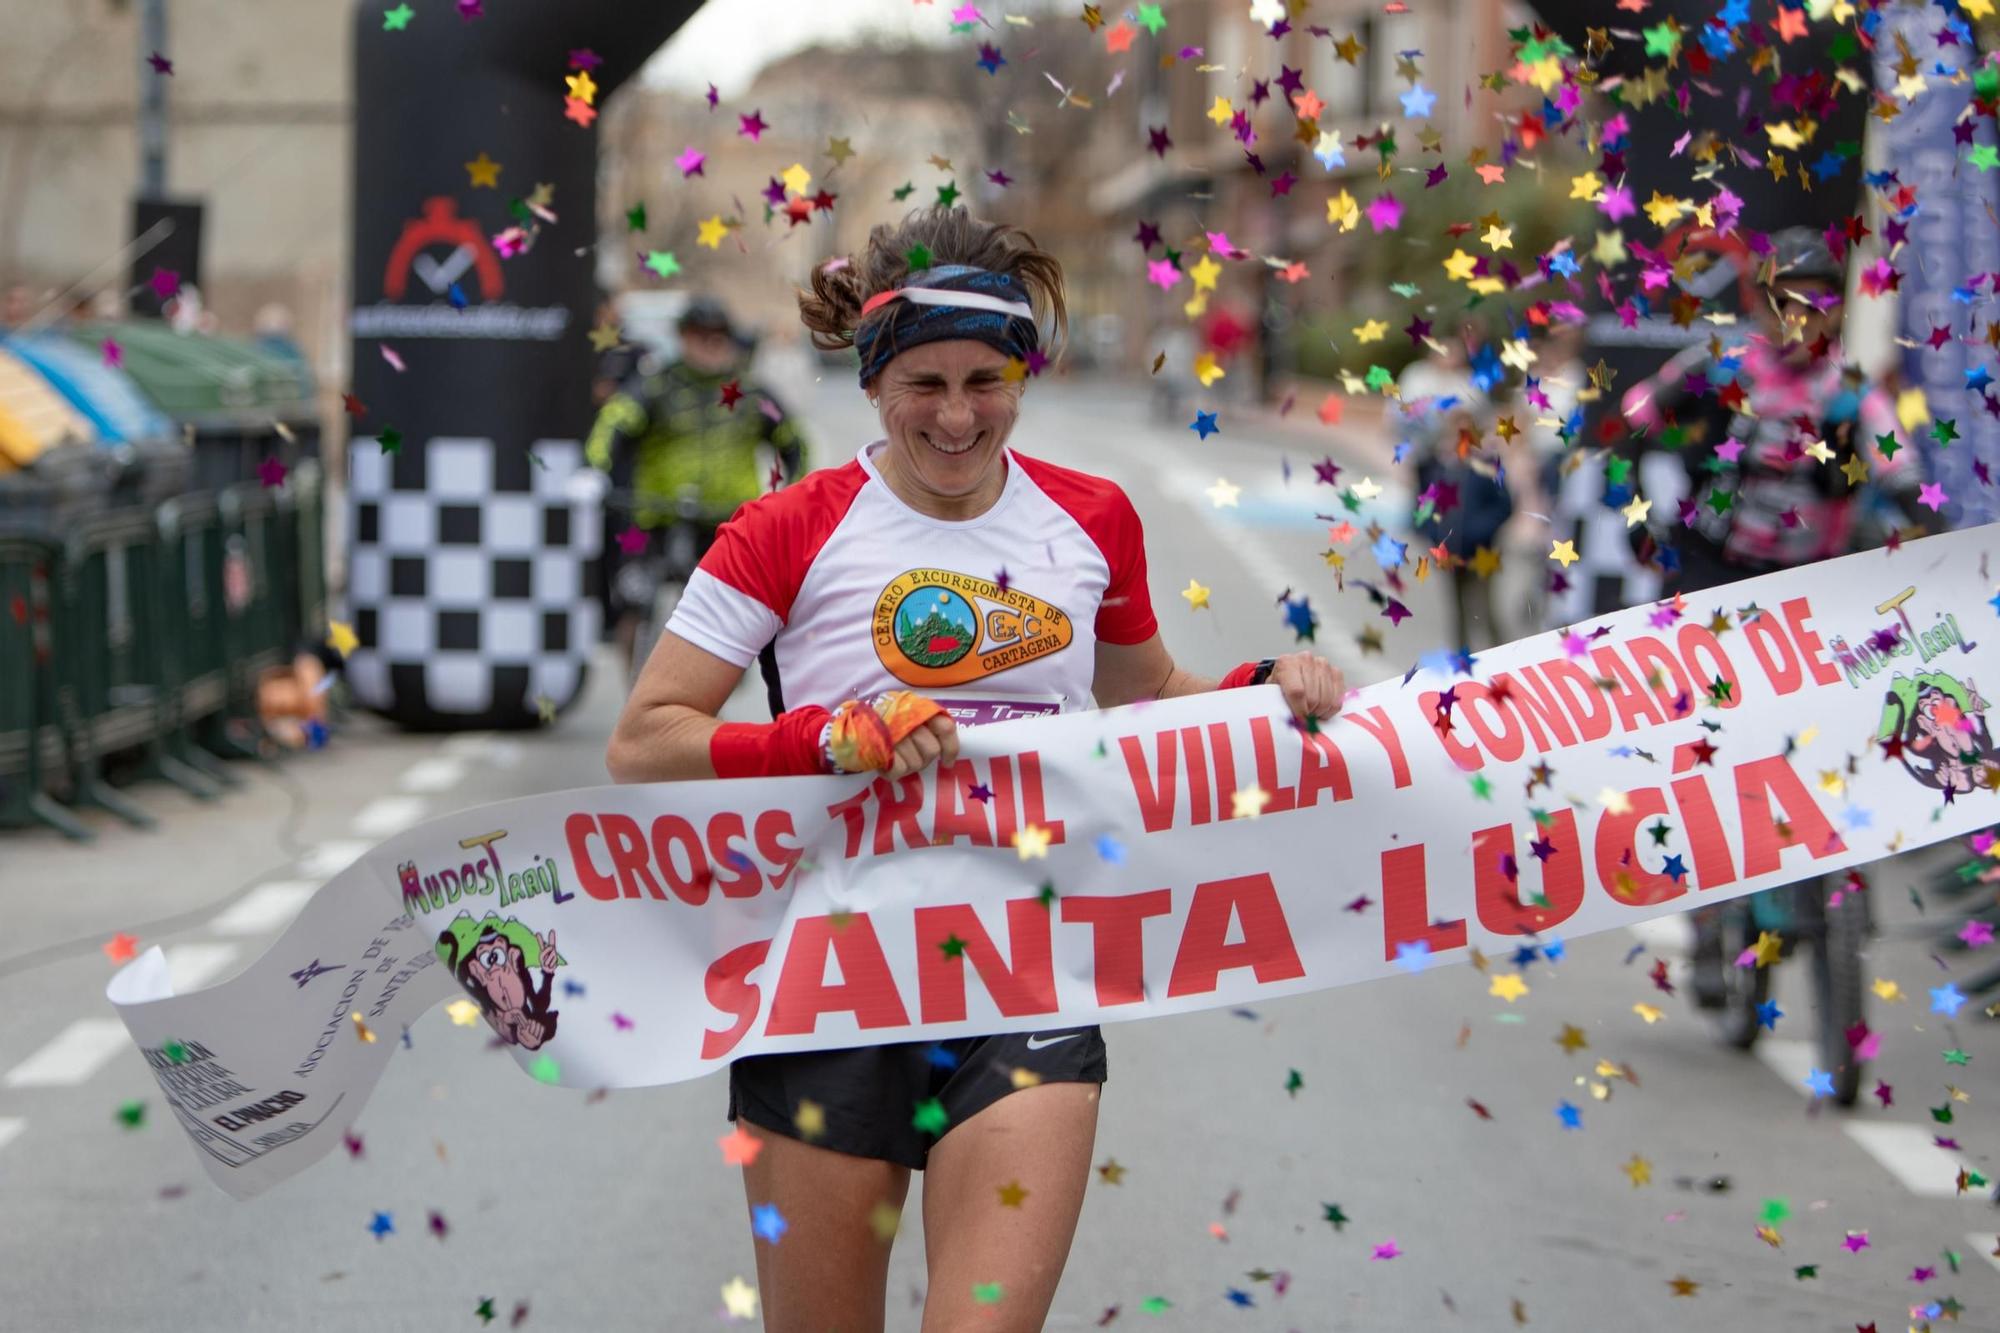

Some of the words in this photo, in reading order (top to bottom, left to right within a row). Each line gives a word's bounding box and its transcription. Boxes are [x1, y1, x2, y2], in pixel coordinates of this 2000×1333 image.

[878, 584, 904, 646] CENTRO
[910, 571, 1036, 613] EXCURSIONISTA
[1043, 606, 1063, 626] DE
[982, 634, 1062, 671] CARTAGENA
[564, 809, 804, 906] CROSS
[827, 750, 1066, 859] TRAIL
[1118, 716, 1354, 833] VILLA
[1342, 705, 1413, 789] Y
[1417, 622, 1742, 773] CONDADO
[1743, 596, 1843, 696] DE
[701, 873, 1306, 1061] SANTA
[1380, 739, 1849, 963] LUCÍA
[361, 937, 390, 960] DE
[213, 1115, 249, 1132] EL
